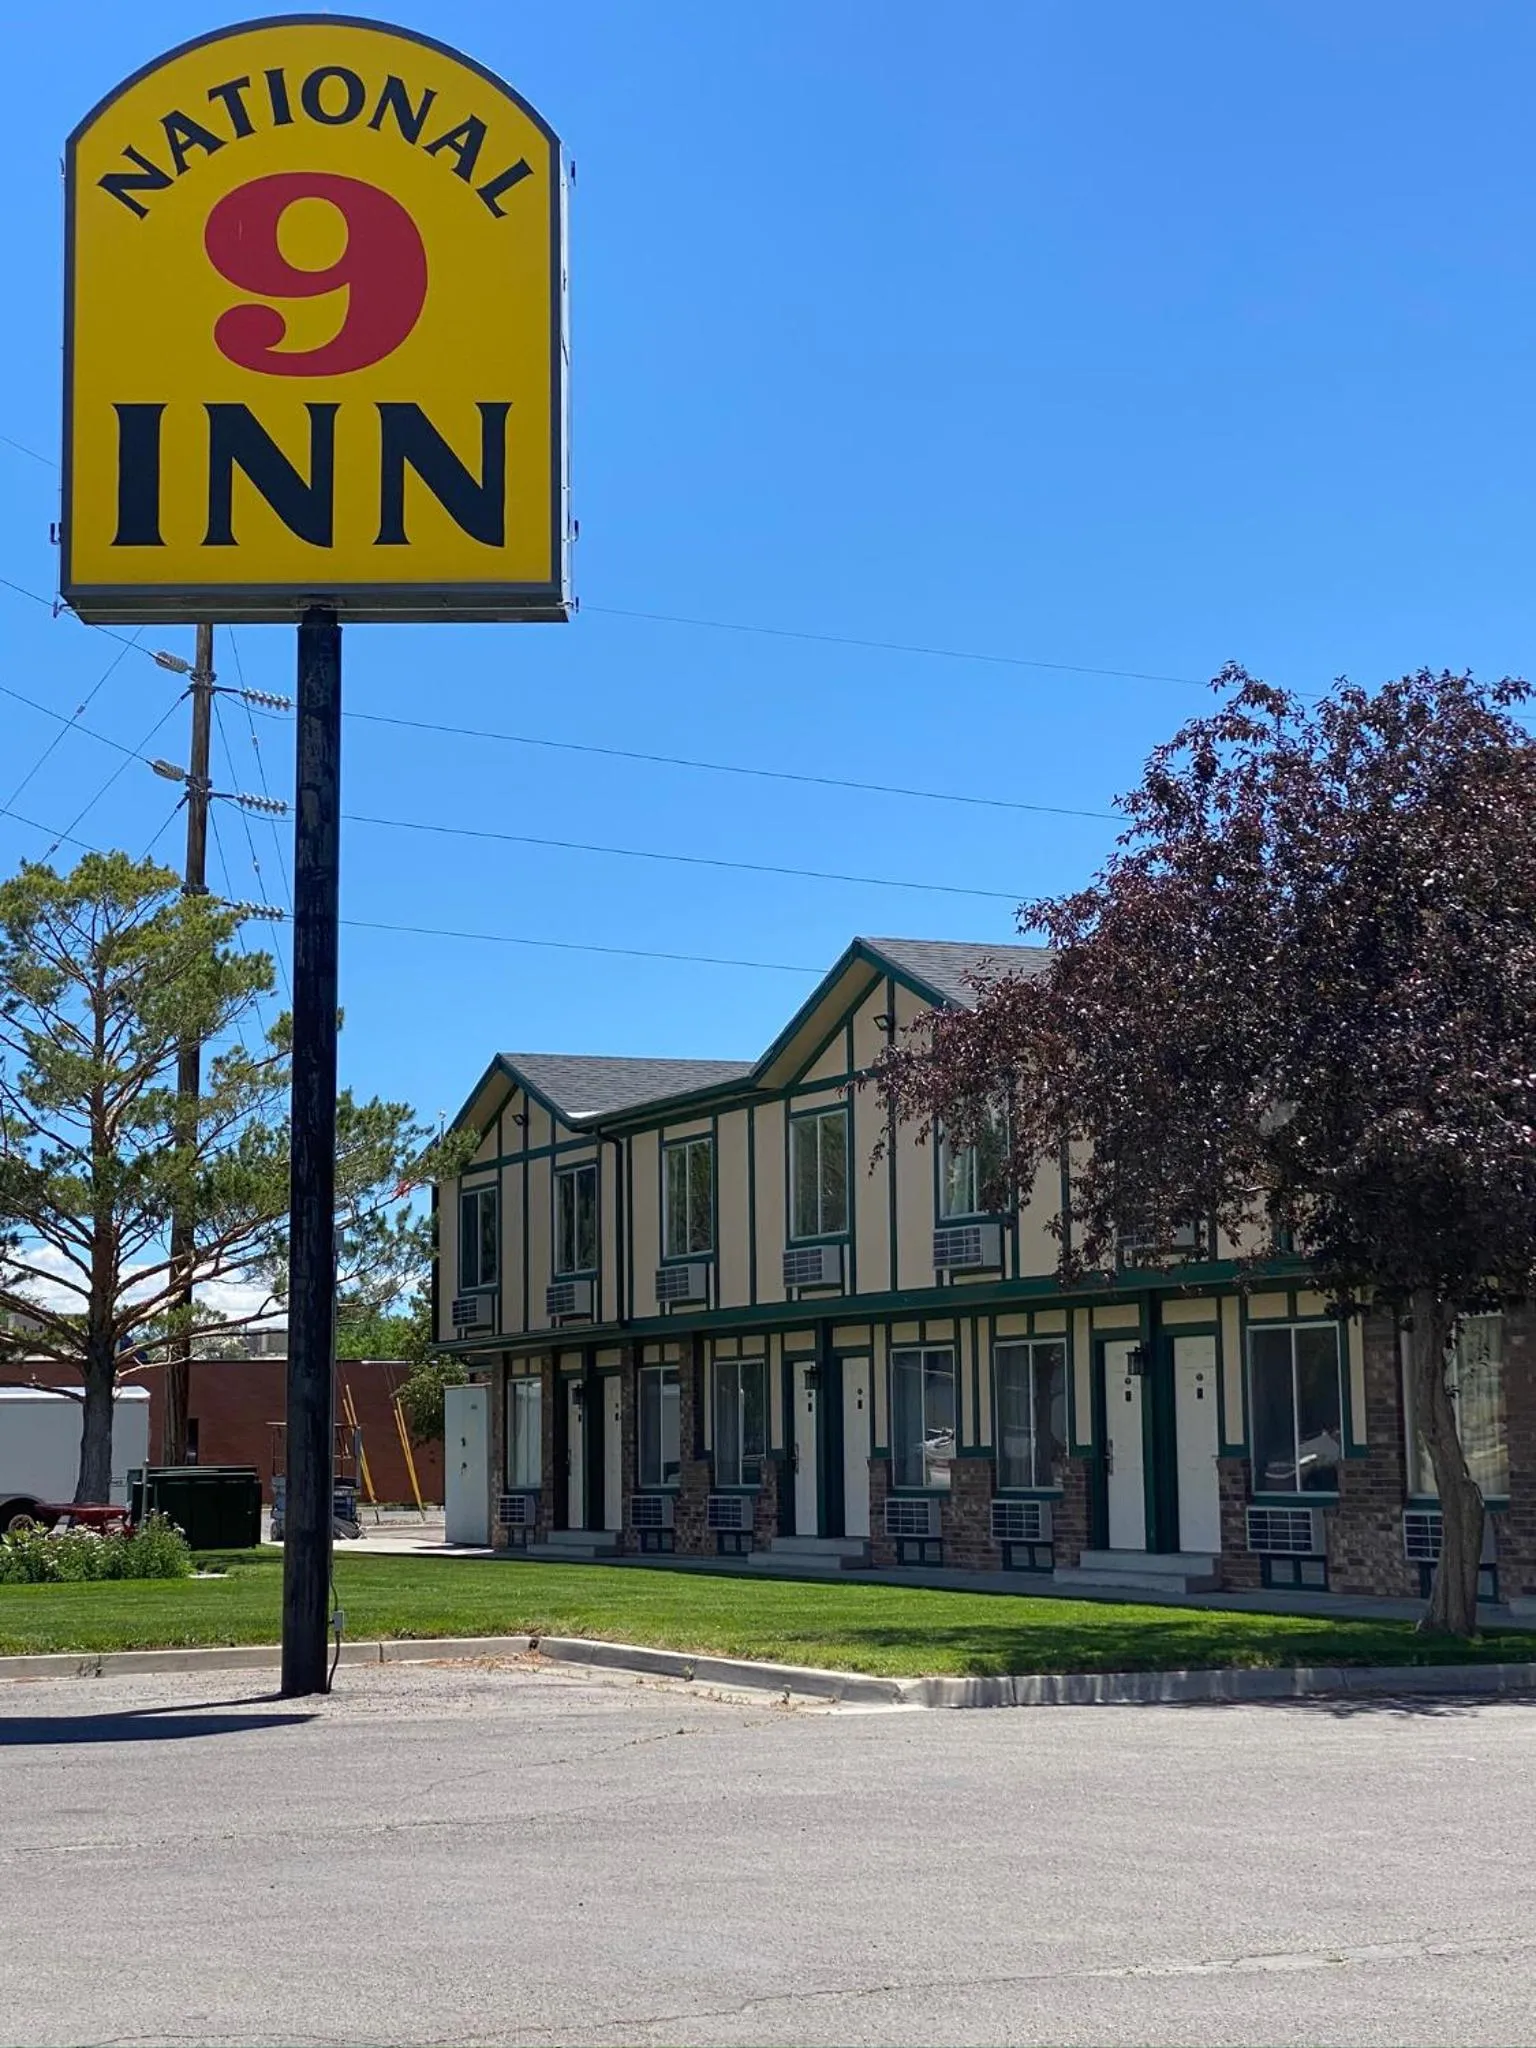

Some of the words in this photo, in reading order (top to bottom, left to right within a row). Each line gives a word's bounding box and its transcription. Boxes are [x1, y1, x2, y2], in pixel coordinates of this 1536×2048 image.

[97, 66, 534, 220] NATIONAL
[204, 171, 428, 378] 9
[110, 401, 513, 549] INN
